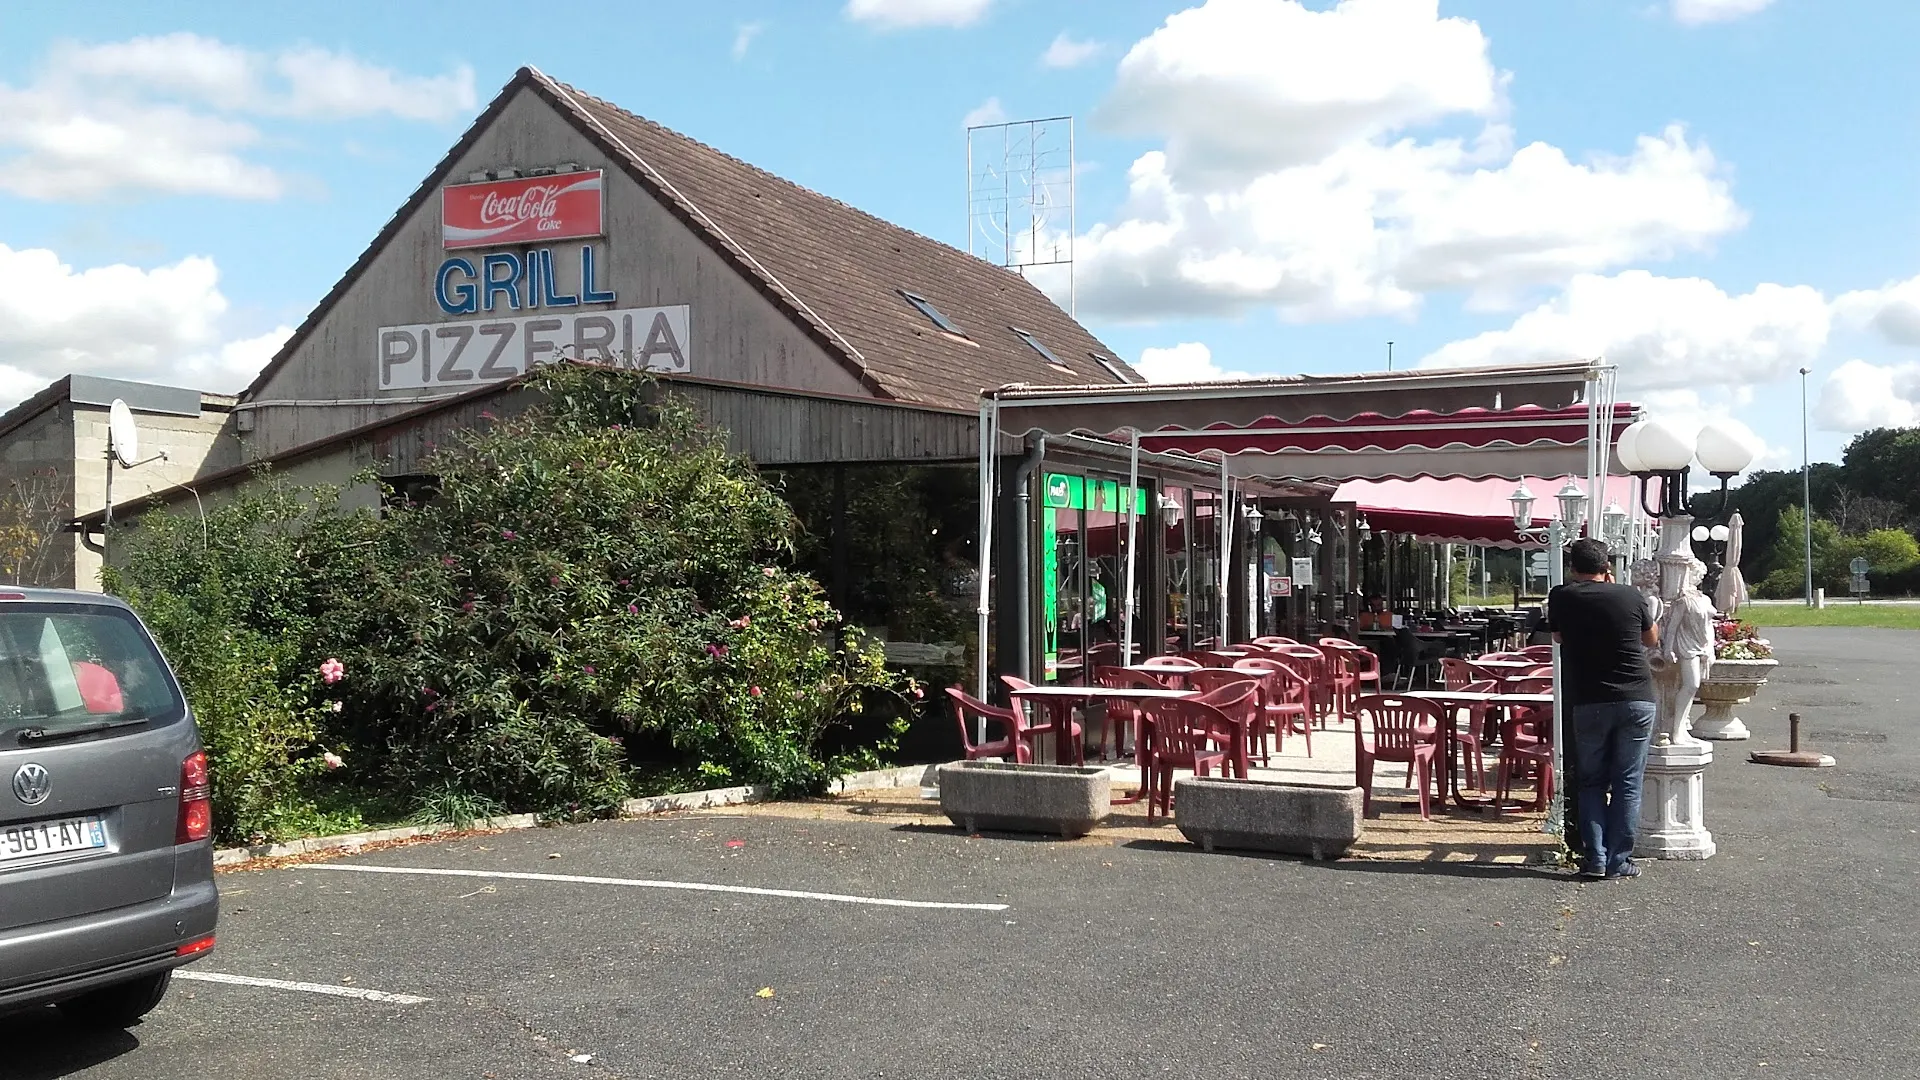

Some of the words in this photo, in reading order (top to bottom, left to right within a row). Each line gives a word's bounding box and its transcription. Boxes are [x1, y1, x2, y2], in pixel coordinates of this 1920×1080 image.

[537, 217, 562, 231] Coke
[434, 246, 615, 314] GRILL
[381, 311, 685, 386] PIZZERIA
